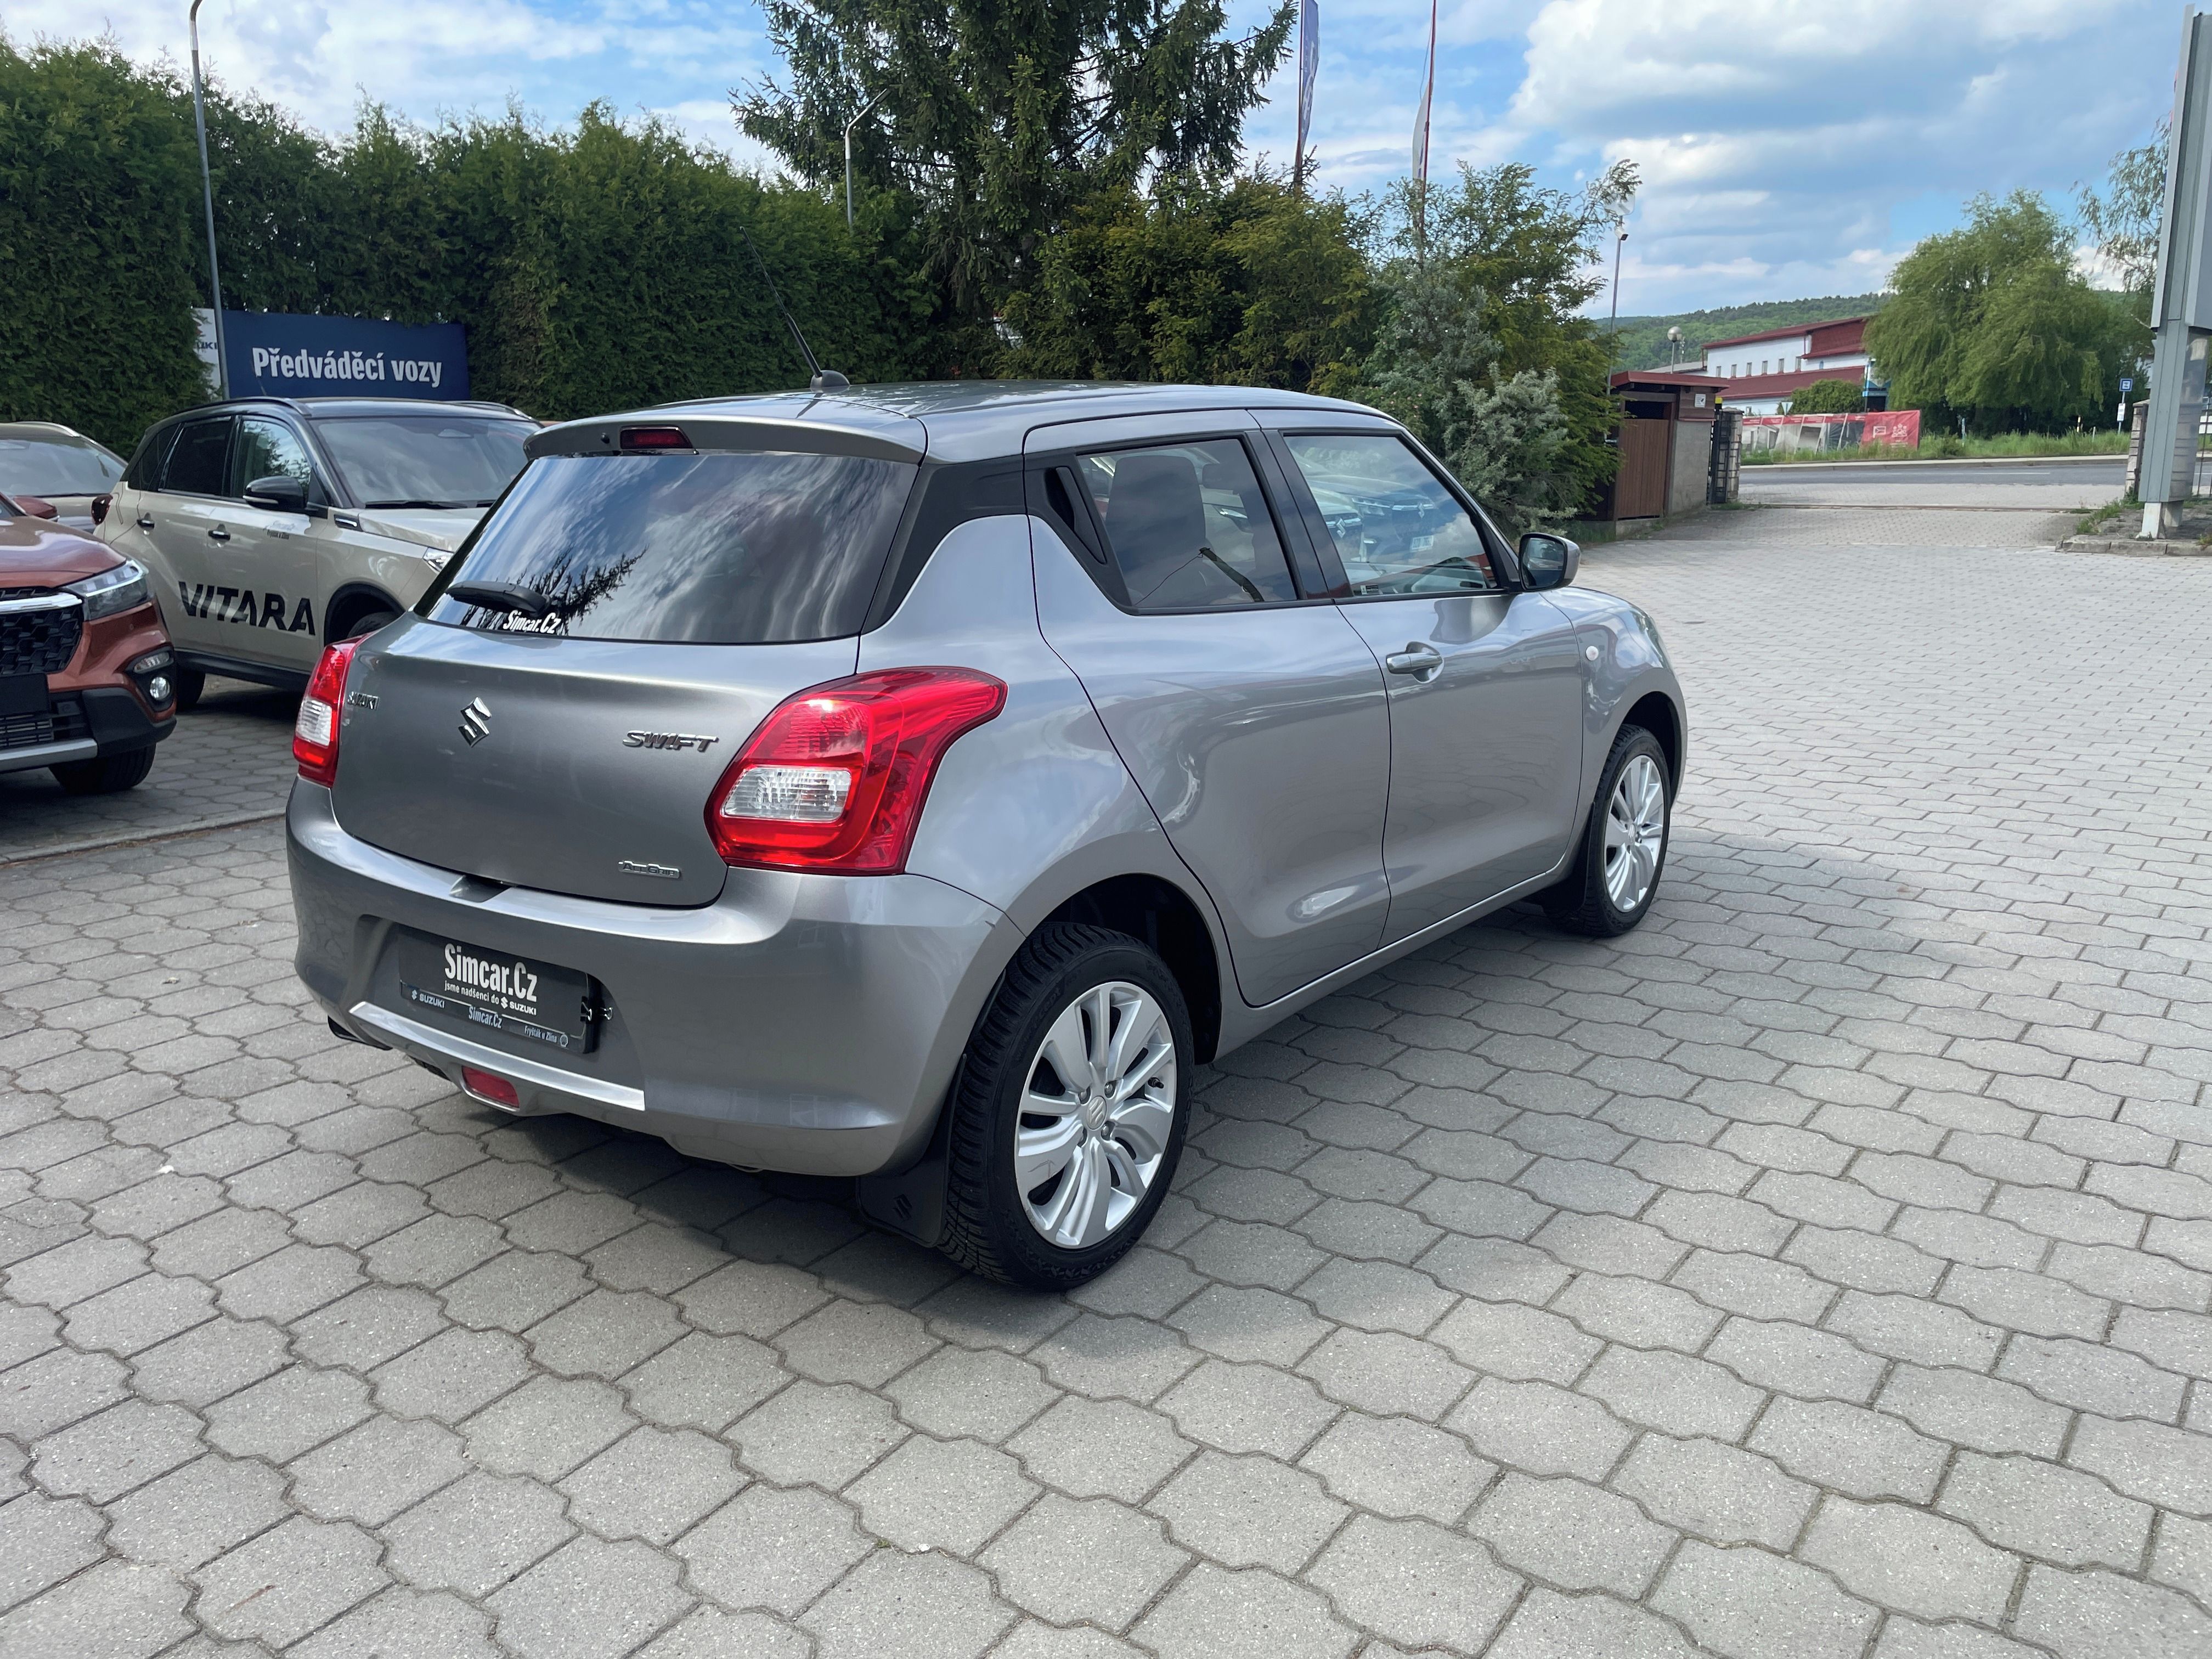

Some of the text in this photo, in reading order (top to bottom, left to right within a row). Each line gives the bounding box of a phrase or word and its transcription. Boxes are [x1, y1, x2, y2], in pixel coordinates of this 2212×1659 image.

[252, 347, 442, 388] Předváděcí vozy
[178, 581, 315, 636] VITARA
[503, 610, 561, 634] Simcar.Cz
[623, 730, 719, 752] SWIFT
[444, 943, 537, 1002] Simcar.Cz
[419, 994, 445, 1008] SUZUKI
[444, 980, 537, 1015] jsme nadšenci do SUZUKI
[469, 1006, 503, 1029] Simcar.Cz
